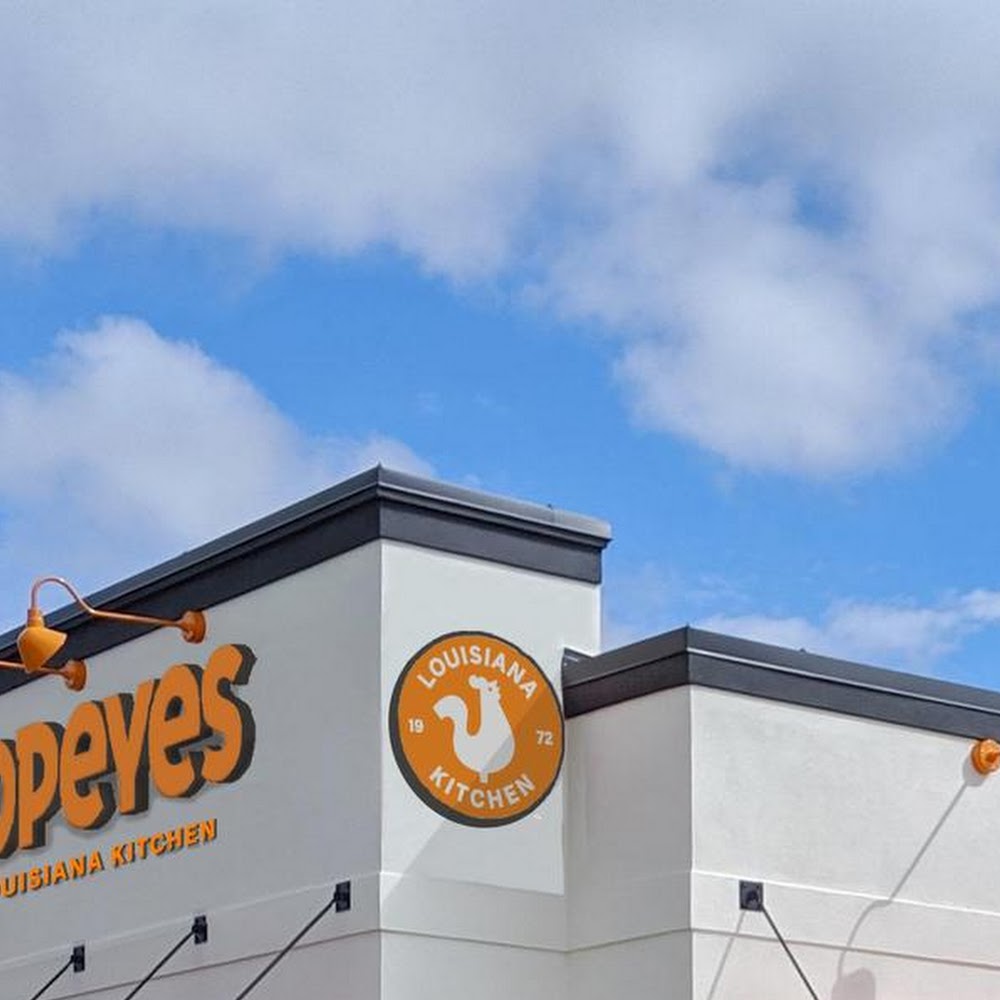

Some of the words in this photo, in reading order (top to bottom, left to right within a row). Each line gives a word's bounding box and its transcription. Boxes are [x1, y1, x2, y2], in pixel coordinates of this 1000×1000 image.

[416, 645, 538, 700] LOUISIANA
[408, 718, 425, 734] 19
[536, 730, 554, 746] 72
[429, 765, 536, 809] KITCHEN
[0, 850, 105, 898] UISIANA
[110, 817, 218, 868] KITCHEN
